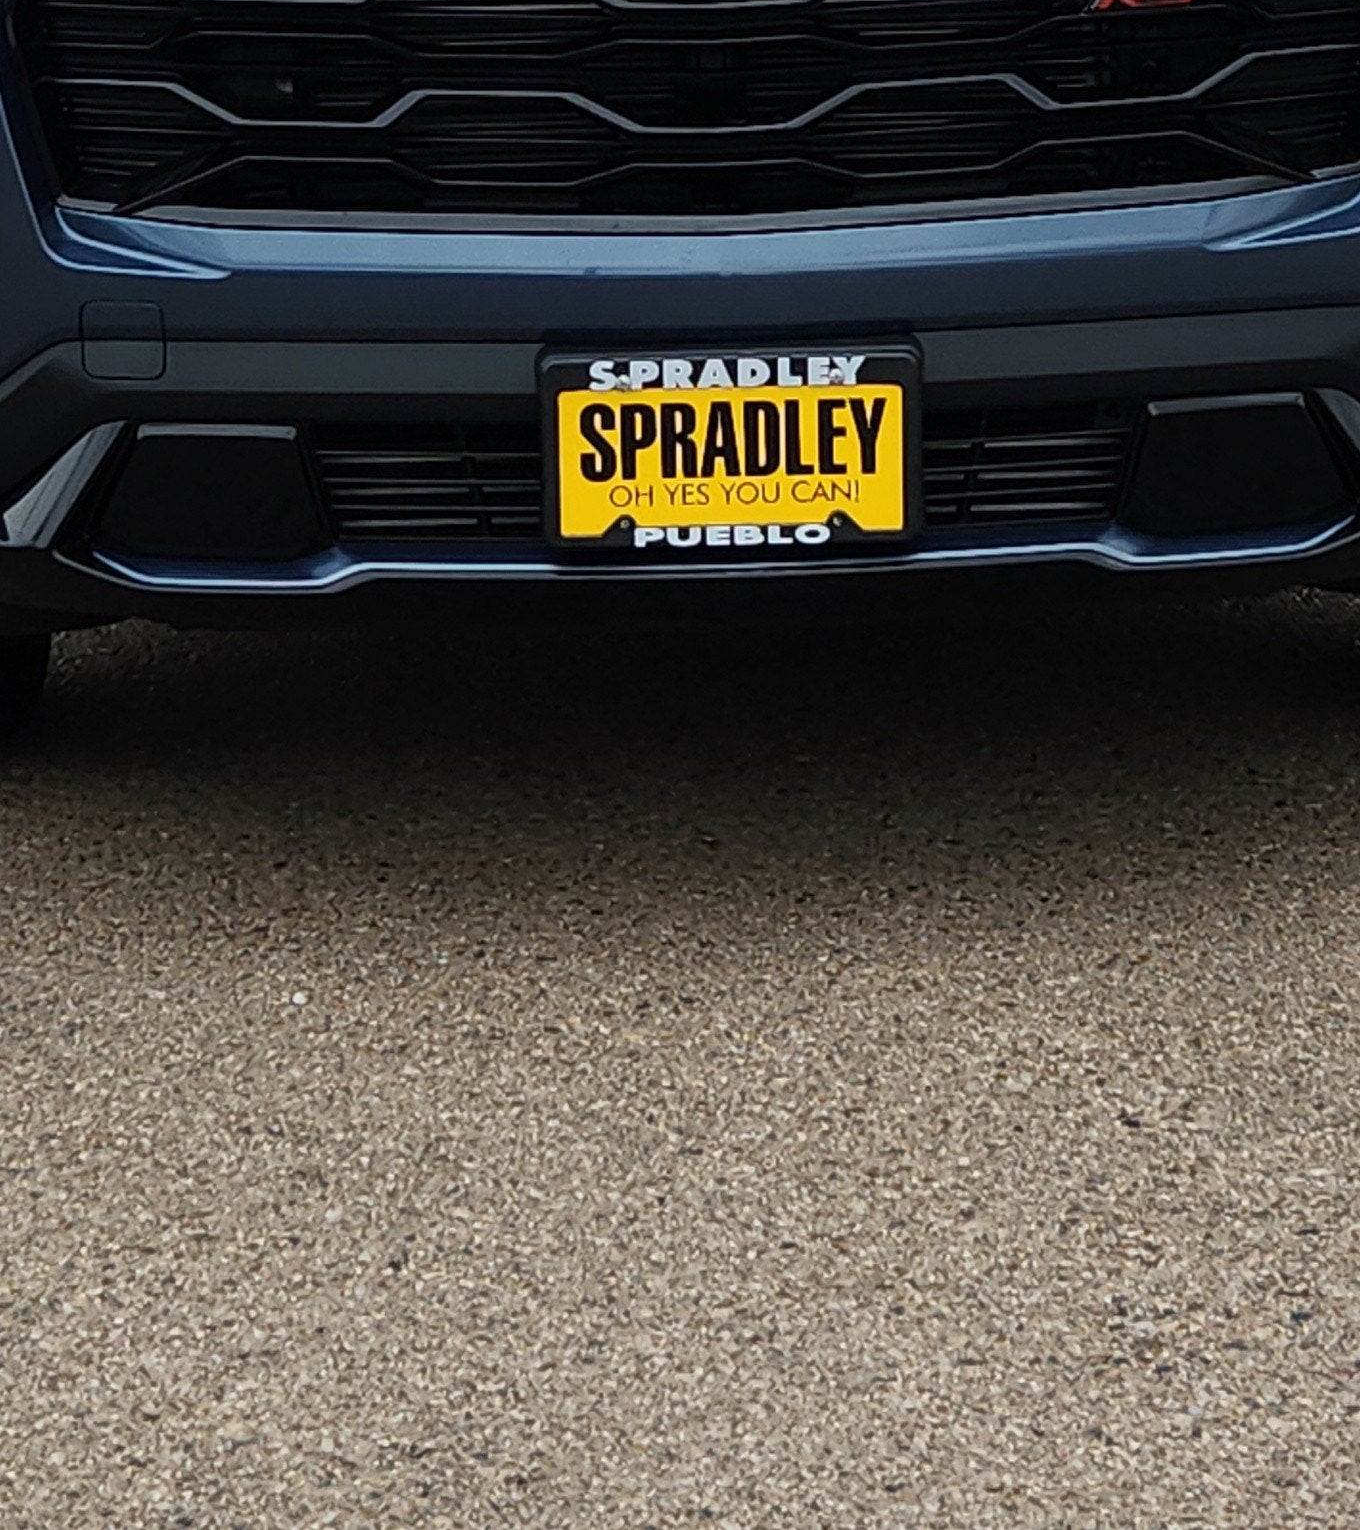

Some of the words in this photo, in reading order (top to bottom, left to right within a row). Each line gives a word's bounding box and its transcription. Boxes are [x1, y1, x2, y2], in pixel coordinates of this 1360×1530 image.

[589, 355, 865, 391] SPRADLEY
[579, 396, 887, 483] SPRADLEY
[609, 485, 654, 508] OH
[664, 482, 710, 506] YES
[720, 480, 781, 504] YOU
[790, 478, 861, 504] CAN!
[634, 523, 831, 548] PUEBLO
